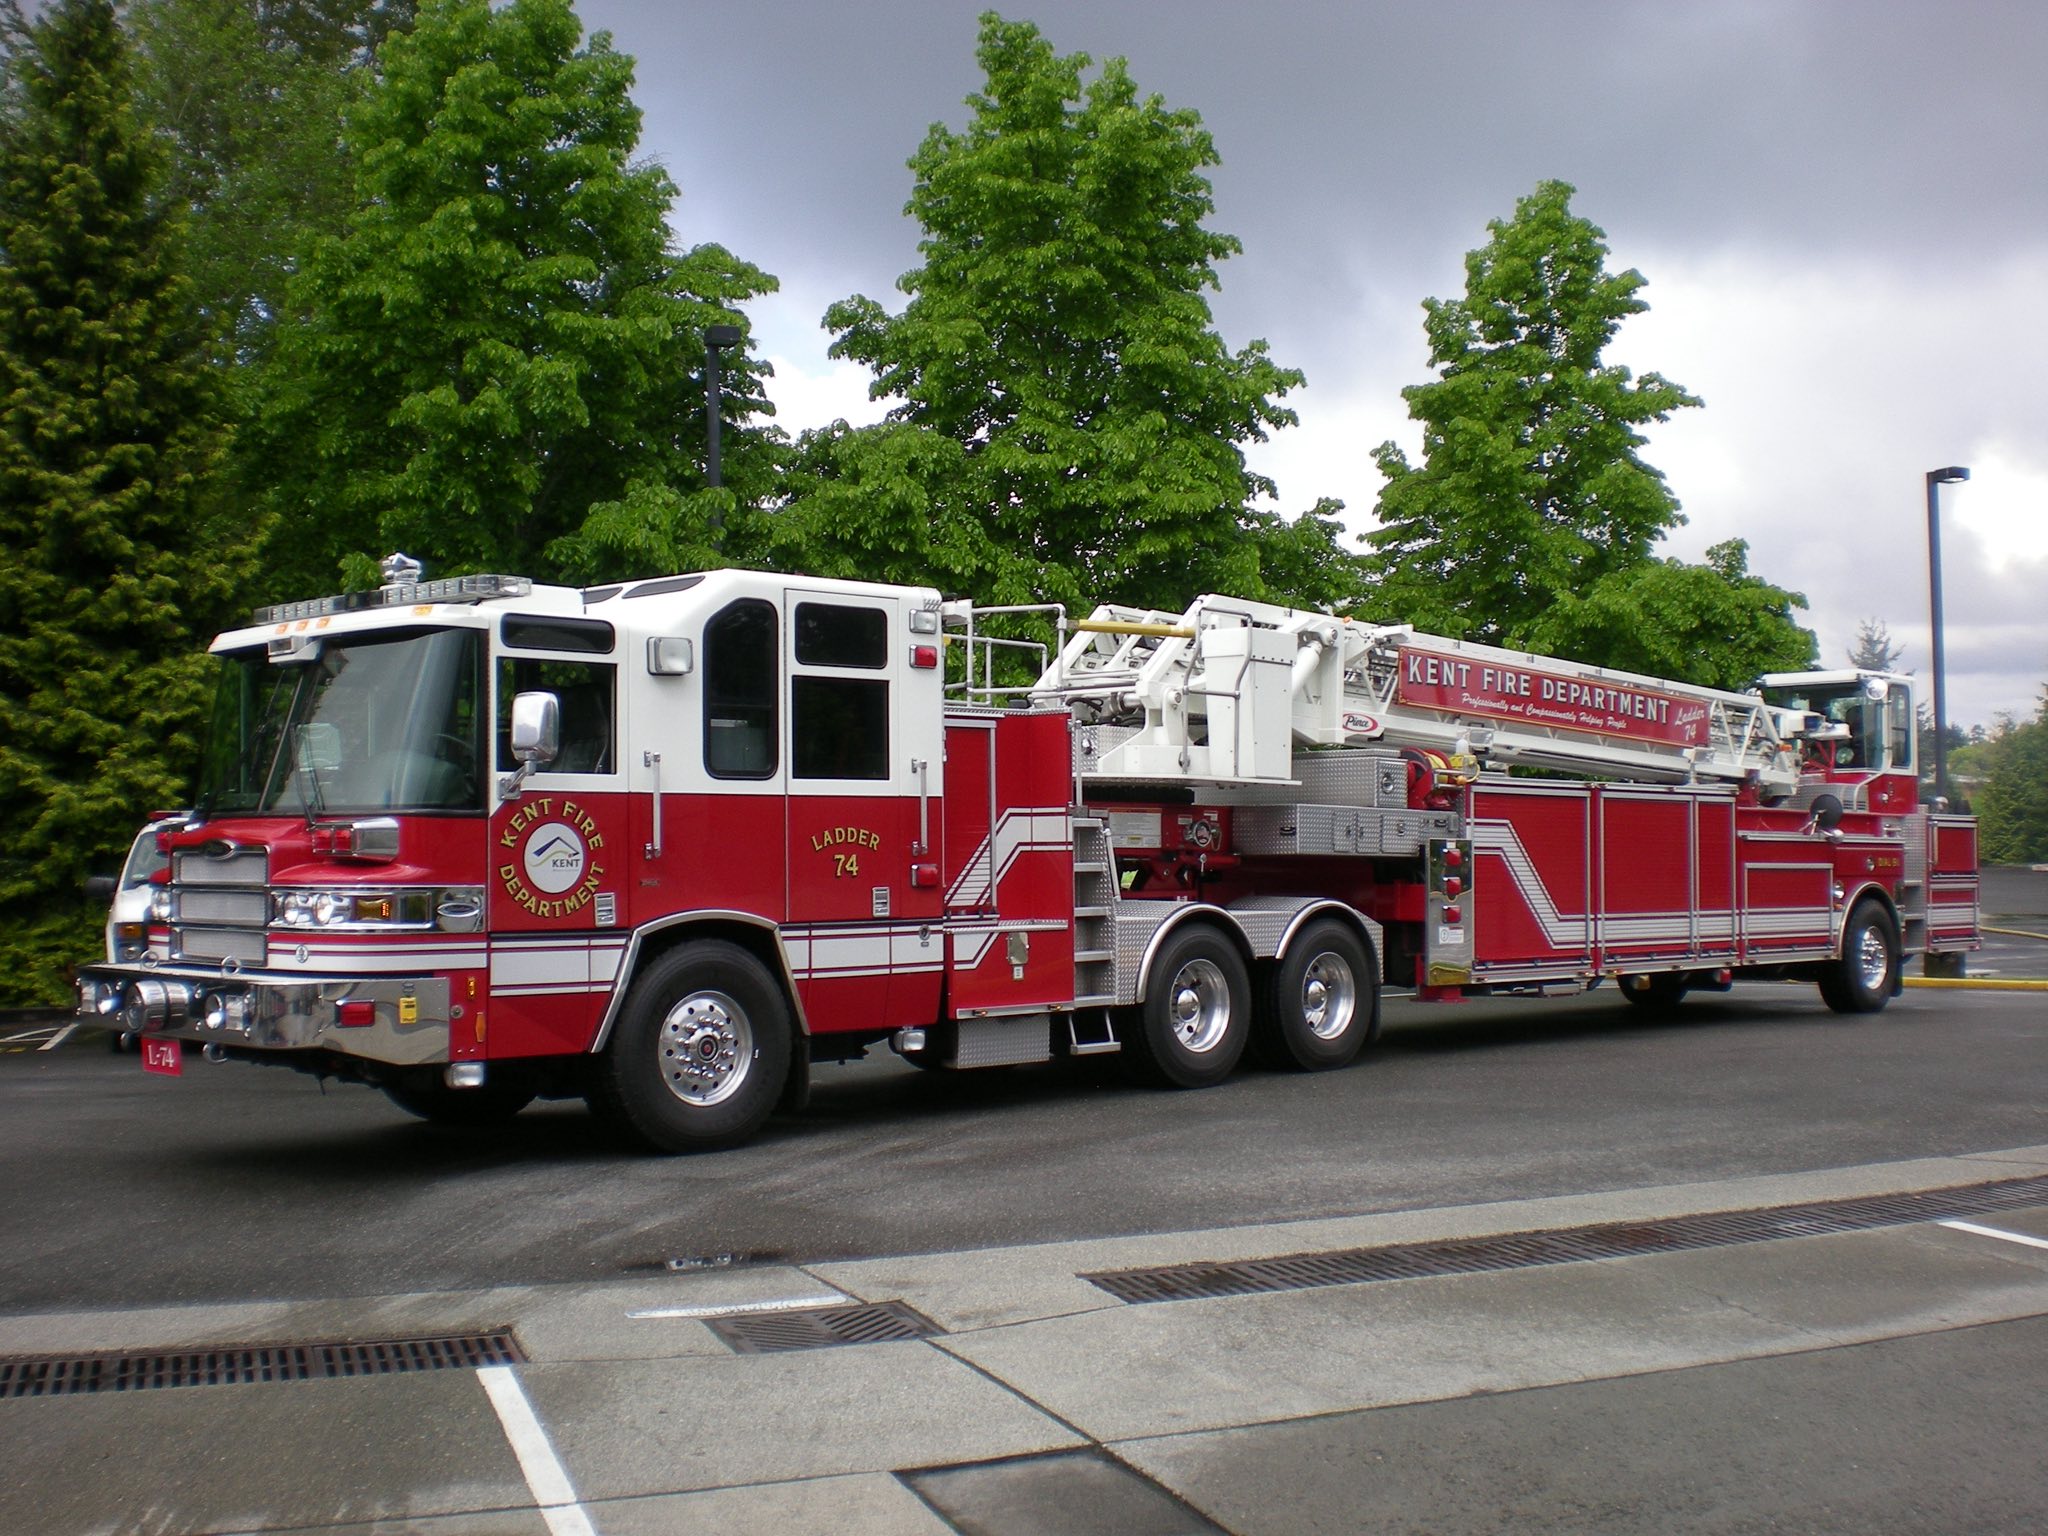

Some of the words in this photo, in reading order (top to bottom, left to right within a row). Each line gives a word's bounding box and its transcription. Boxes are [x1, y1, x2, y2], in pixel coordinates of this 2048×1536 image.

[1408, 654, 1471, 687] KENT
[1482, 668, 1531, 697] FIRE
[1542, 678, 1670, 724] DEPARTMENT
[1345, 715, 1369, 728] Pierce
[1461, 692, 1508, 712] Professionally
[1510, 703, 1523, 713] and
[1526, 703, 1577, 722] Compassionately
[1579, 712, 1604, 727] Helping
[1606, 716, 1627, 730] People
[1674, 705, 1705, 725] Ladder
[1684, 724, 1697, 741] 74
[500, 798, 552, 848] KENT
[562, 800, 604, 850] FIRE
[811, 827, 880, 851] LADDER
[552, 858, 581, 868] KENT
[834, 854, 859, 877] 74
[499, 861, 605, 918] DEPARTMENT
[147, 1044, 175, 1068] L-74
